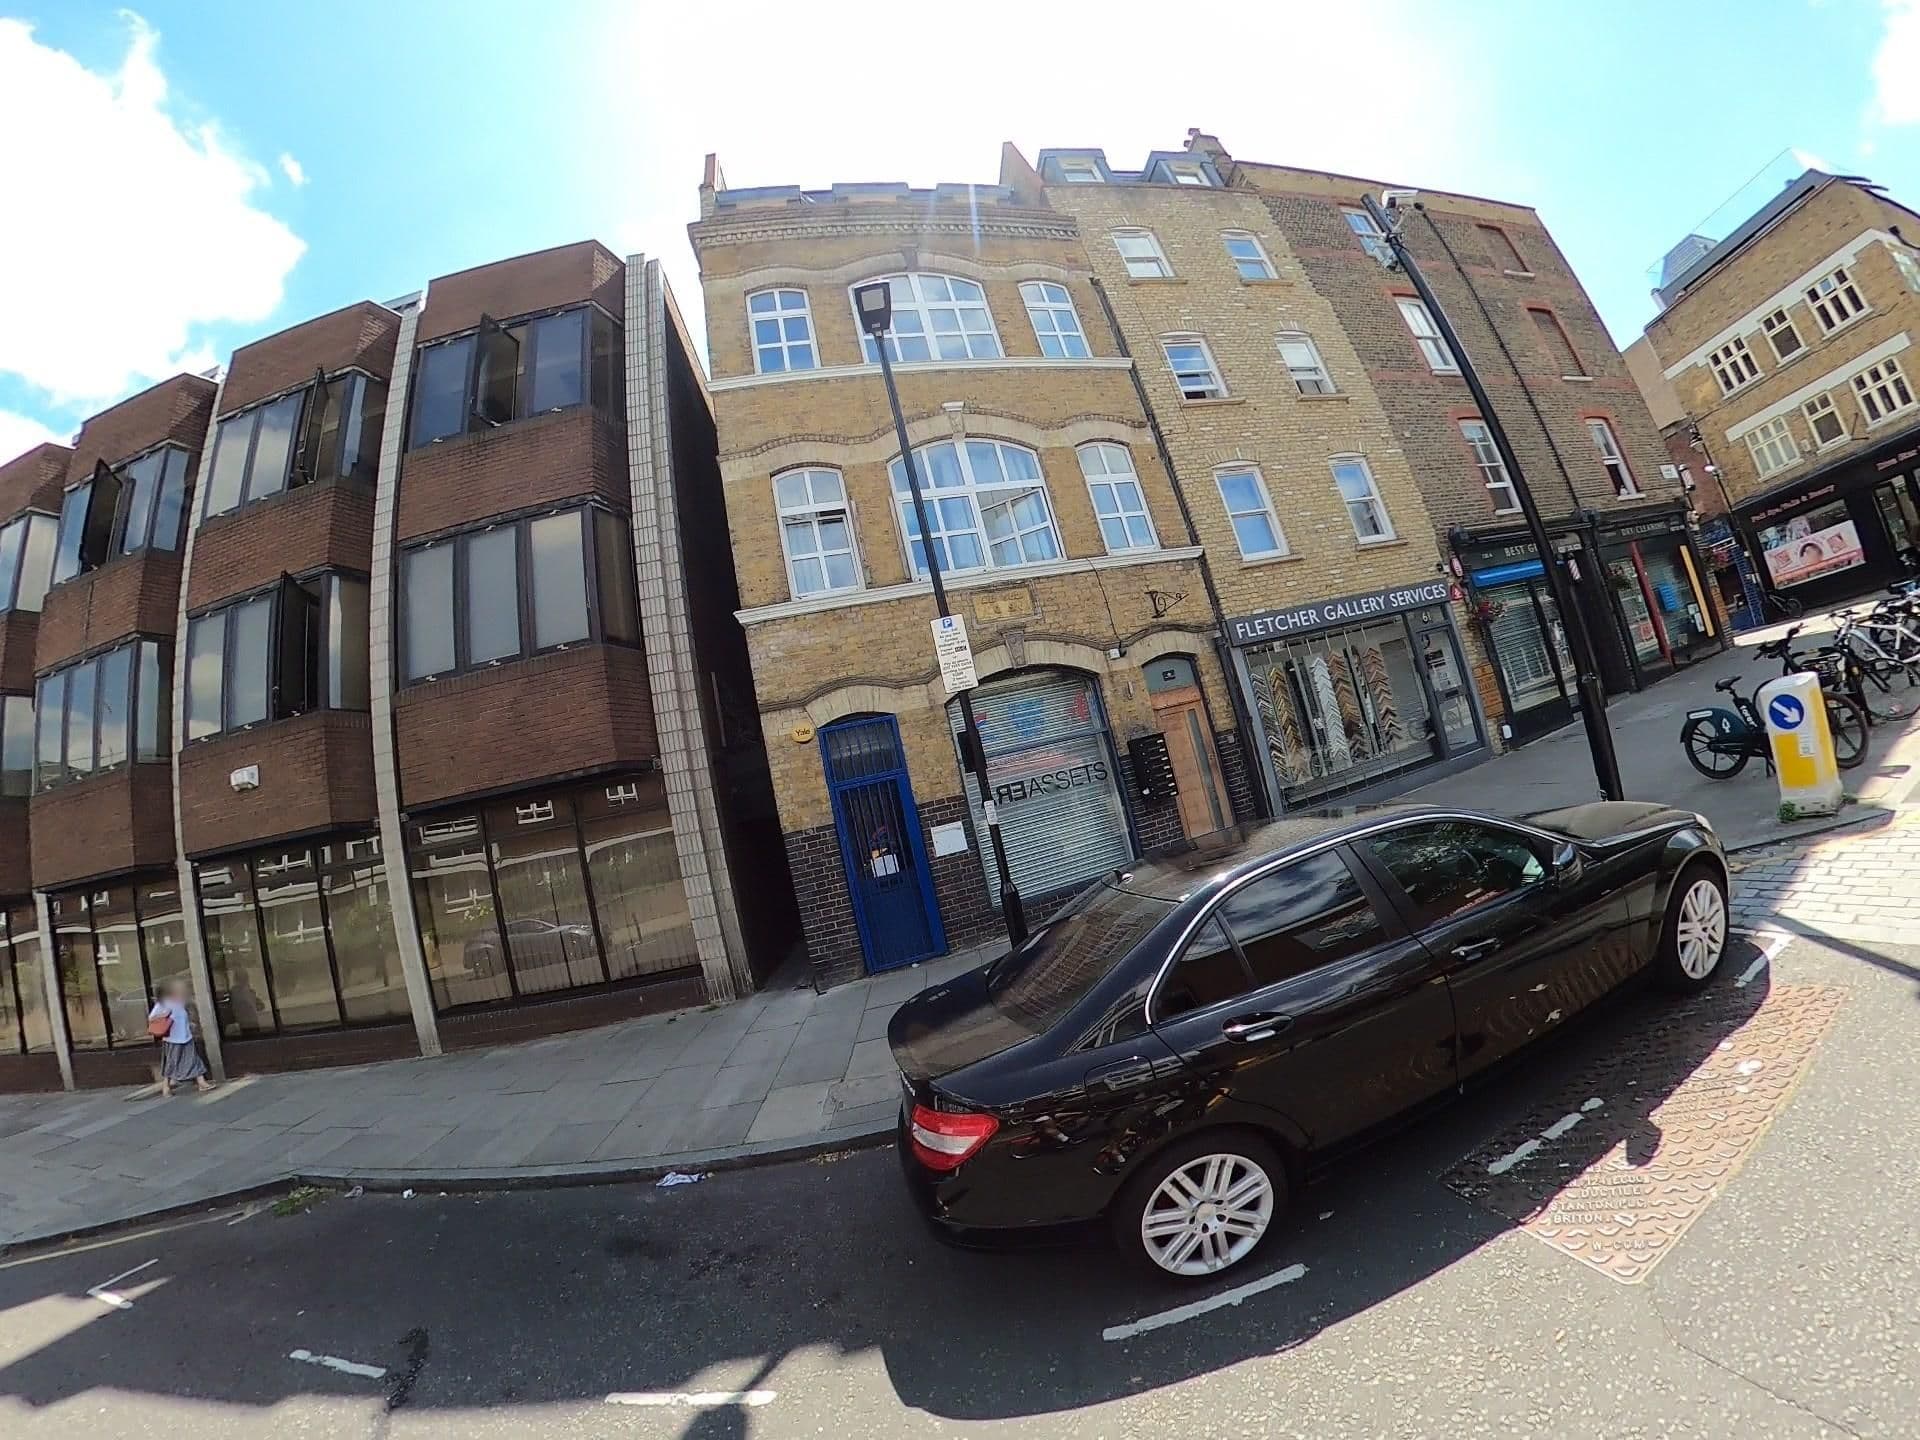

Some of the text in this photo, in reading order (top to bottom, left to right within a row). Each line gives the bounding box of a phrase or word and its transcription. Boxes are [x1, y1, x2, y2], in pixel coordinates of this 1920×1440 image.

[1504, 544, 1525, 557] BEST
[1235, 584, 1447, 639] FLETCHER GALLERY SERVICES
[1422, 611, 1432, 622] 61
[796, 728, 810, 736] Yale
[1581, 1187, 1641, 1199] DUCTILE
